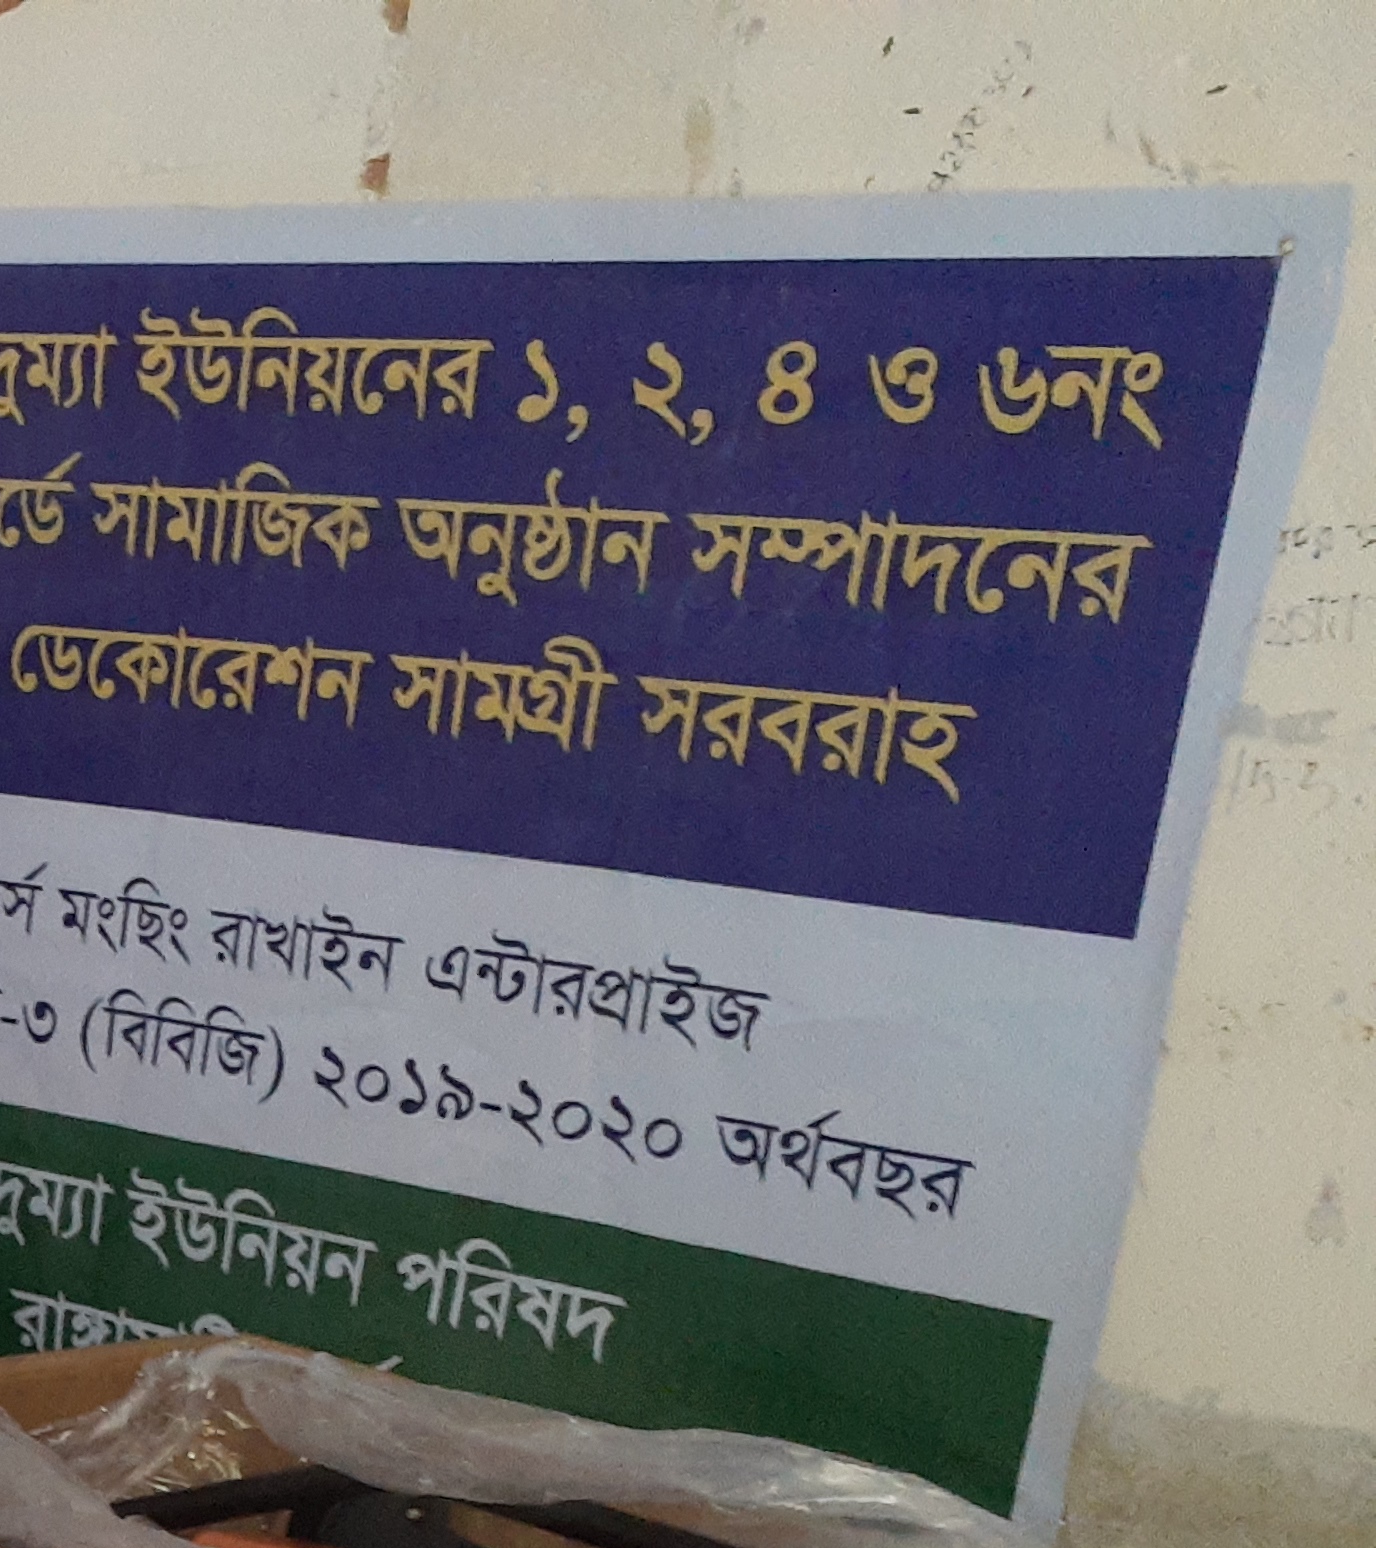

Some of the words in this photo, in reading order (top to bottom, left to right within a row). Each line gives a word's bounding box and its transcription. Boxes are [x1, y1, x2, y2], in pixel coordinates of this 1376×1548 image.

[134, 303, 492, 422] ইউনিয়নের
[756, 339, 818, 425] ৪
[867, 346, 939, 424] ও
[978, 345, 1165, 450] ৬নং
[92, 460, 381, 571] সামাজিক
[399, 468, 668, 606] অনুষ্ঠান
[691, 509, 1153, 625] সম্পাদনের
[12, 624, 374, 734] ডেকোরেশন
[390, 634, 619, 751] সামগ্রী
[639, 673, 977, 804] সরবরাহ
[60, 879, 194, 965] মংছিং
[210, 905, 405, 990] রাখাইন
[426, 932, 772, 1053] এন্টারপ্রাইজ
[80, 990, 285, 1104] (বিবিজি)
[312, 1045, 684, 1166] ২০১৯-২০২০
[716, 1109, 977, 1221] অর্থবছর
[125, 1166, 380, 1306] ইউনিয়ন
[395, 1236, 629, 1365] পরিষদ
